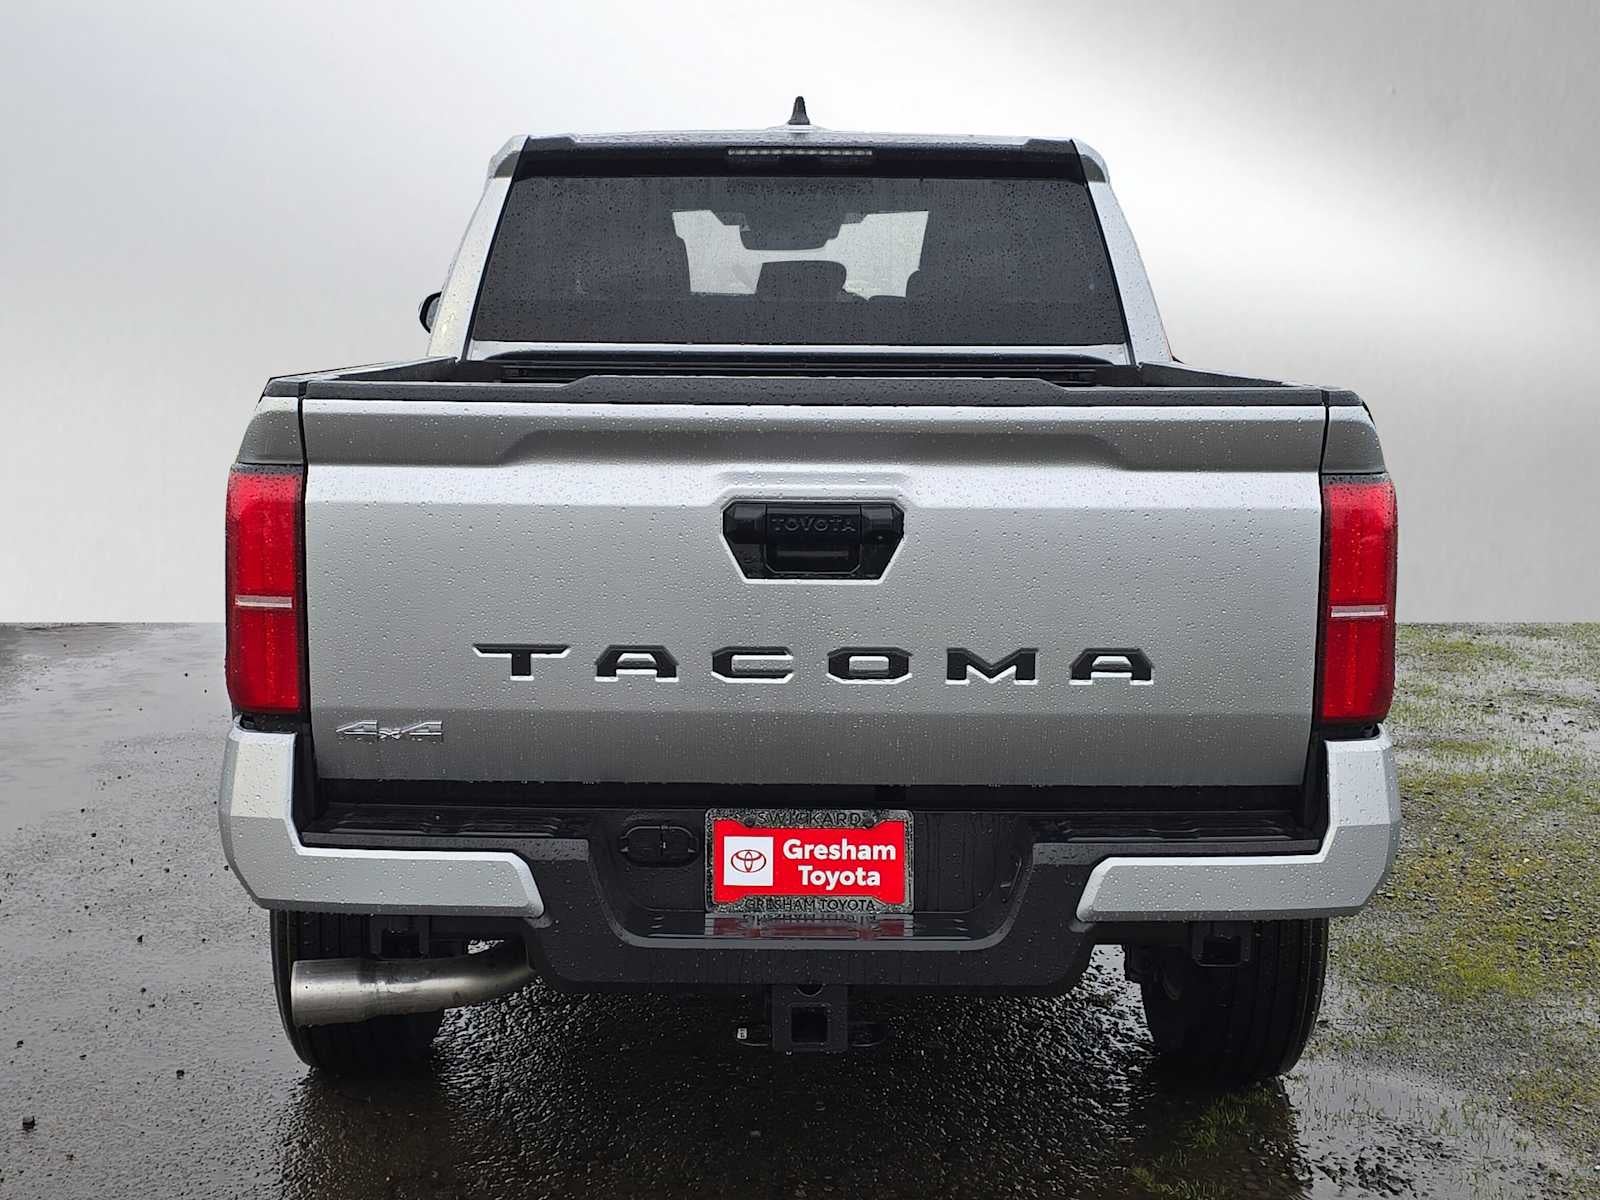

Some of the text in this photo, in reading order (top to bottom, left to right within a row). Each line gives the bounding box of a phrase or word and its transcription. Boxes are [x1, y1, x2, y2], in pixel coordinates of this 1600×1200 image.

[771, 516, 857, 532] TOYOTA
[473, 644, 1155, 685] TACOMA
[756, 812, 862, 826] SWICKARD
[782, 838, 897, 860] Gresham
[797, 865, 881, 891] Toyota
[744, 899, 876, 911] GRESHAM TOYOTA
